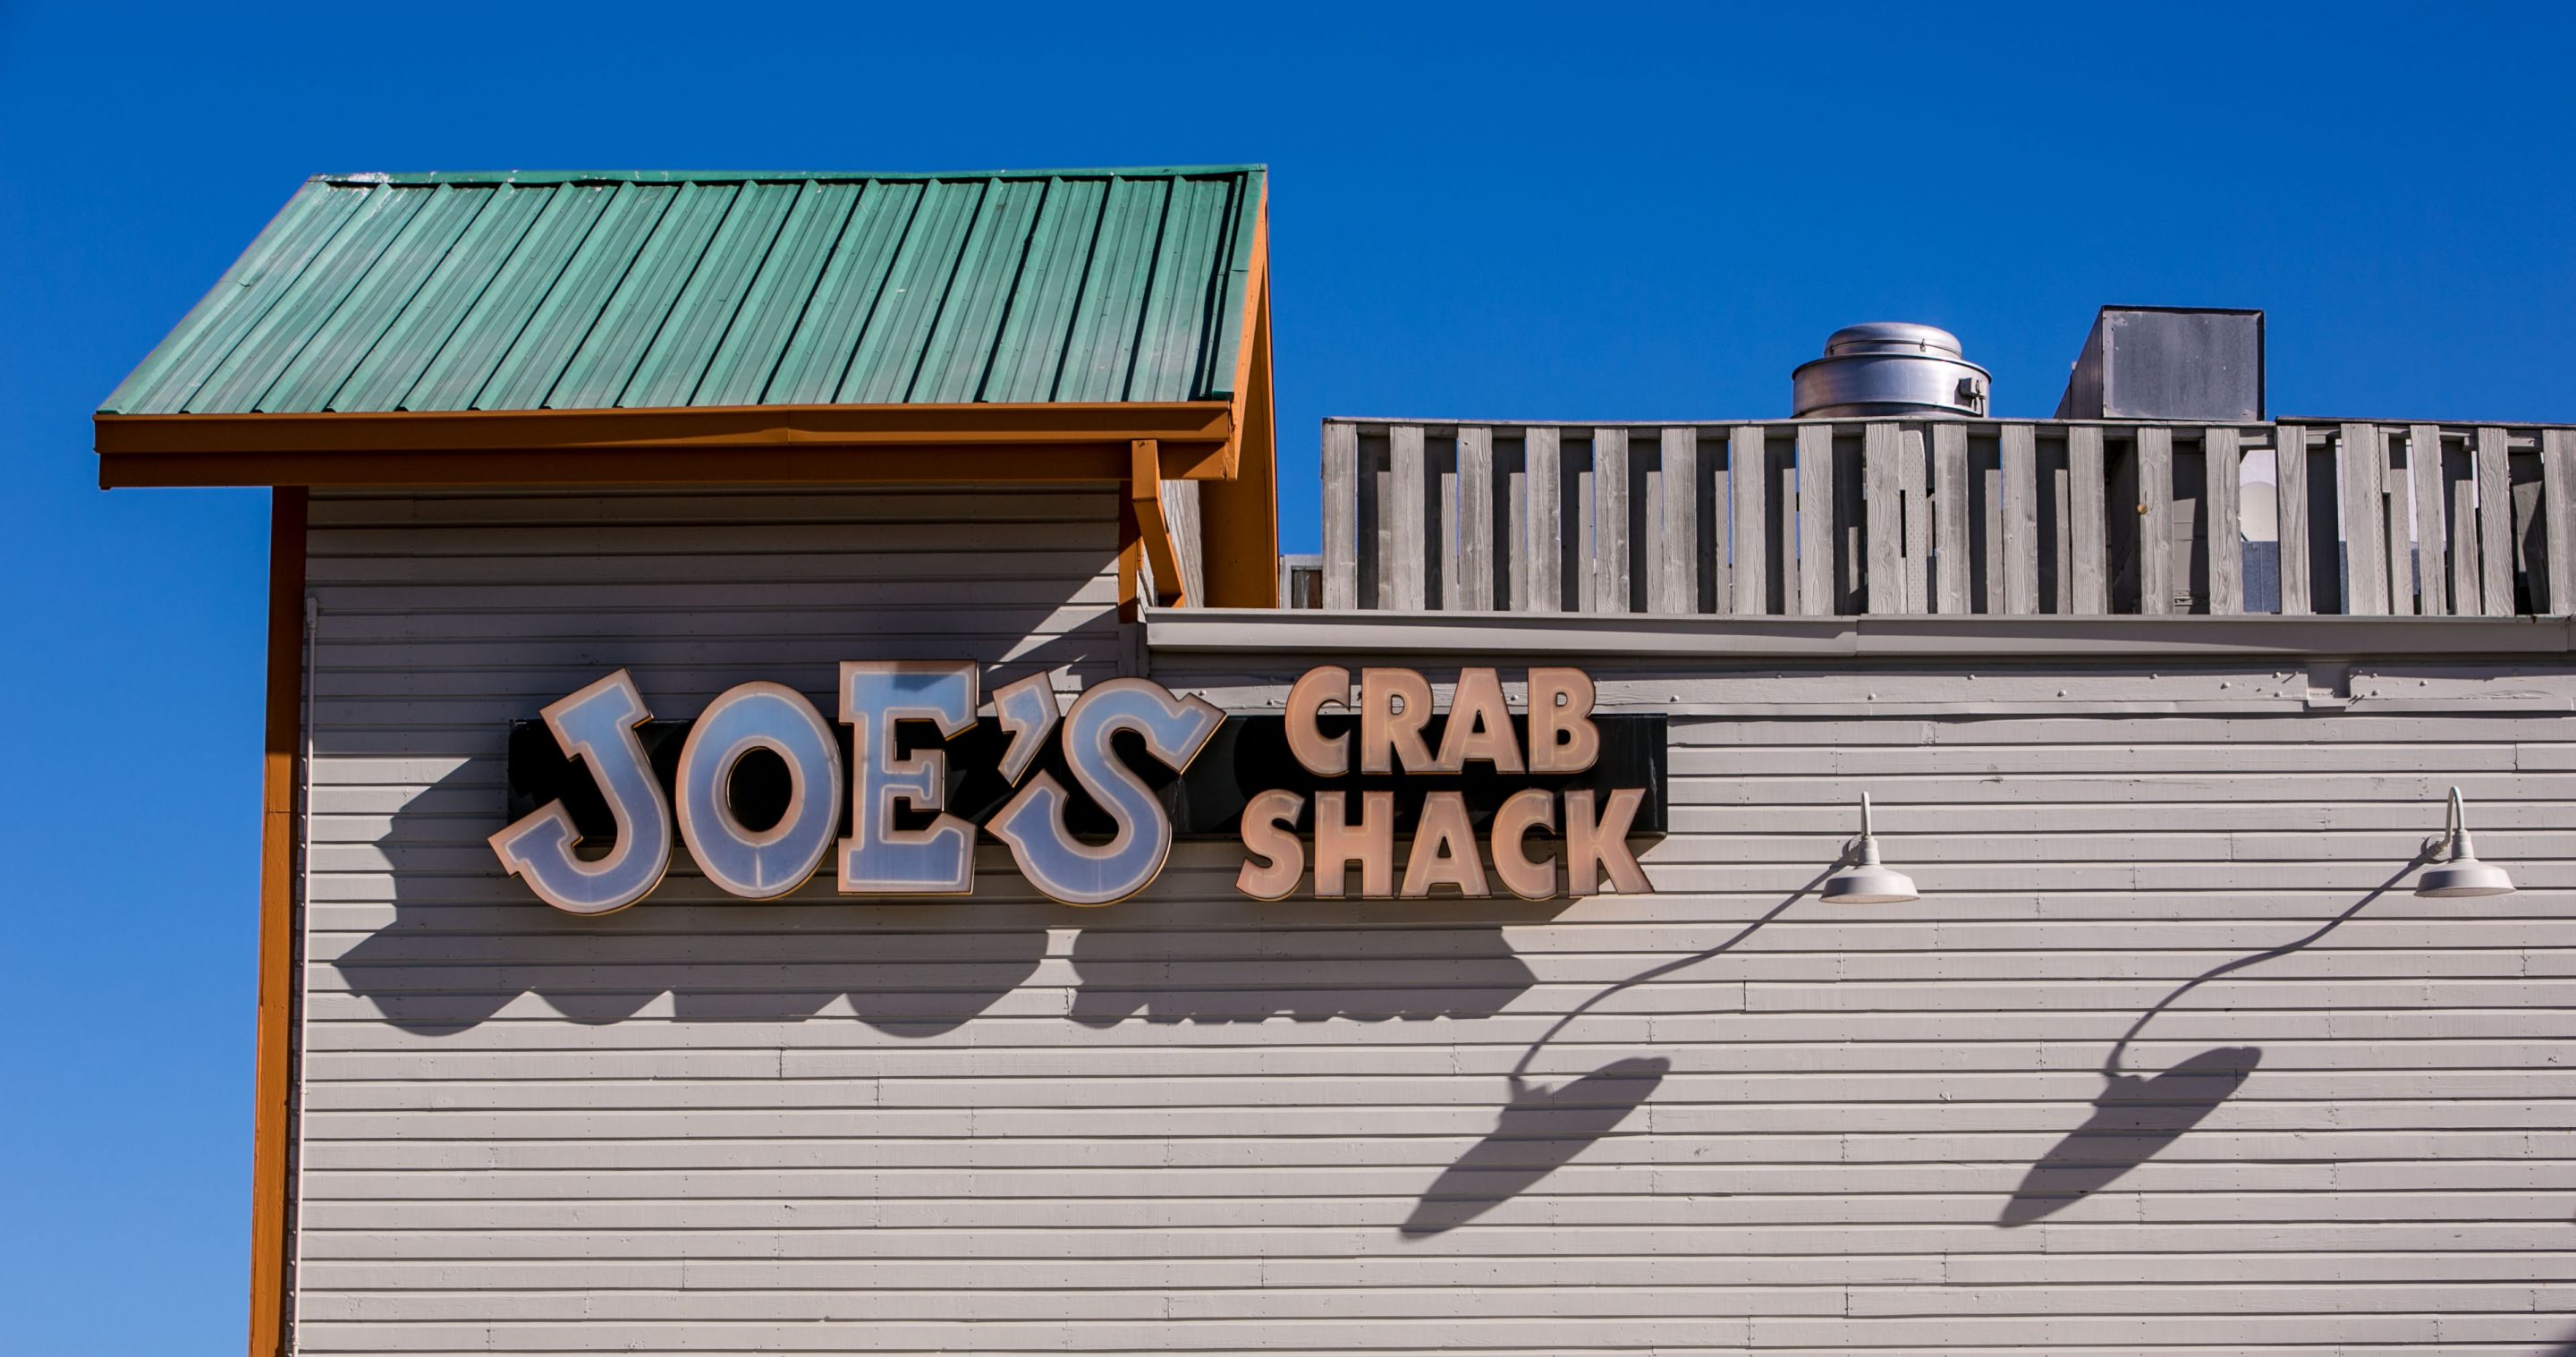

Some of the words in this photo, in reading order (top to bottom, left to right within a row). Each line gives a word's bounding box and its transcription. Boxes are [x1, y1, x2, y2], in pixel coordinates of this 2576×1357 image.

[1285, 665, 1600, 777] CRAB
[487, 660, 1226, 916] JOE'S
[1235, 788, 1656, 902] SHACK
